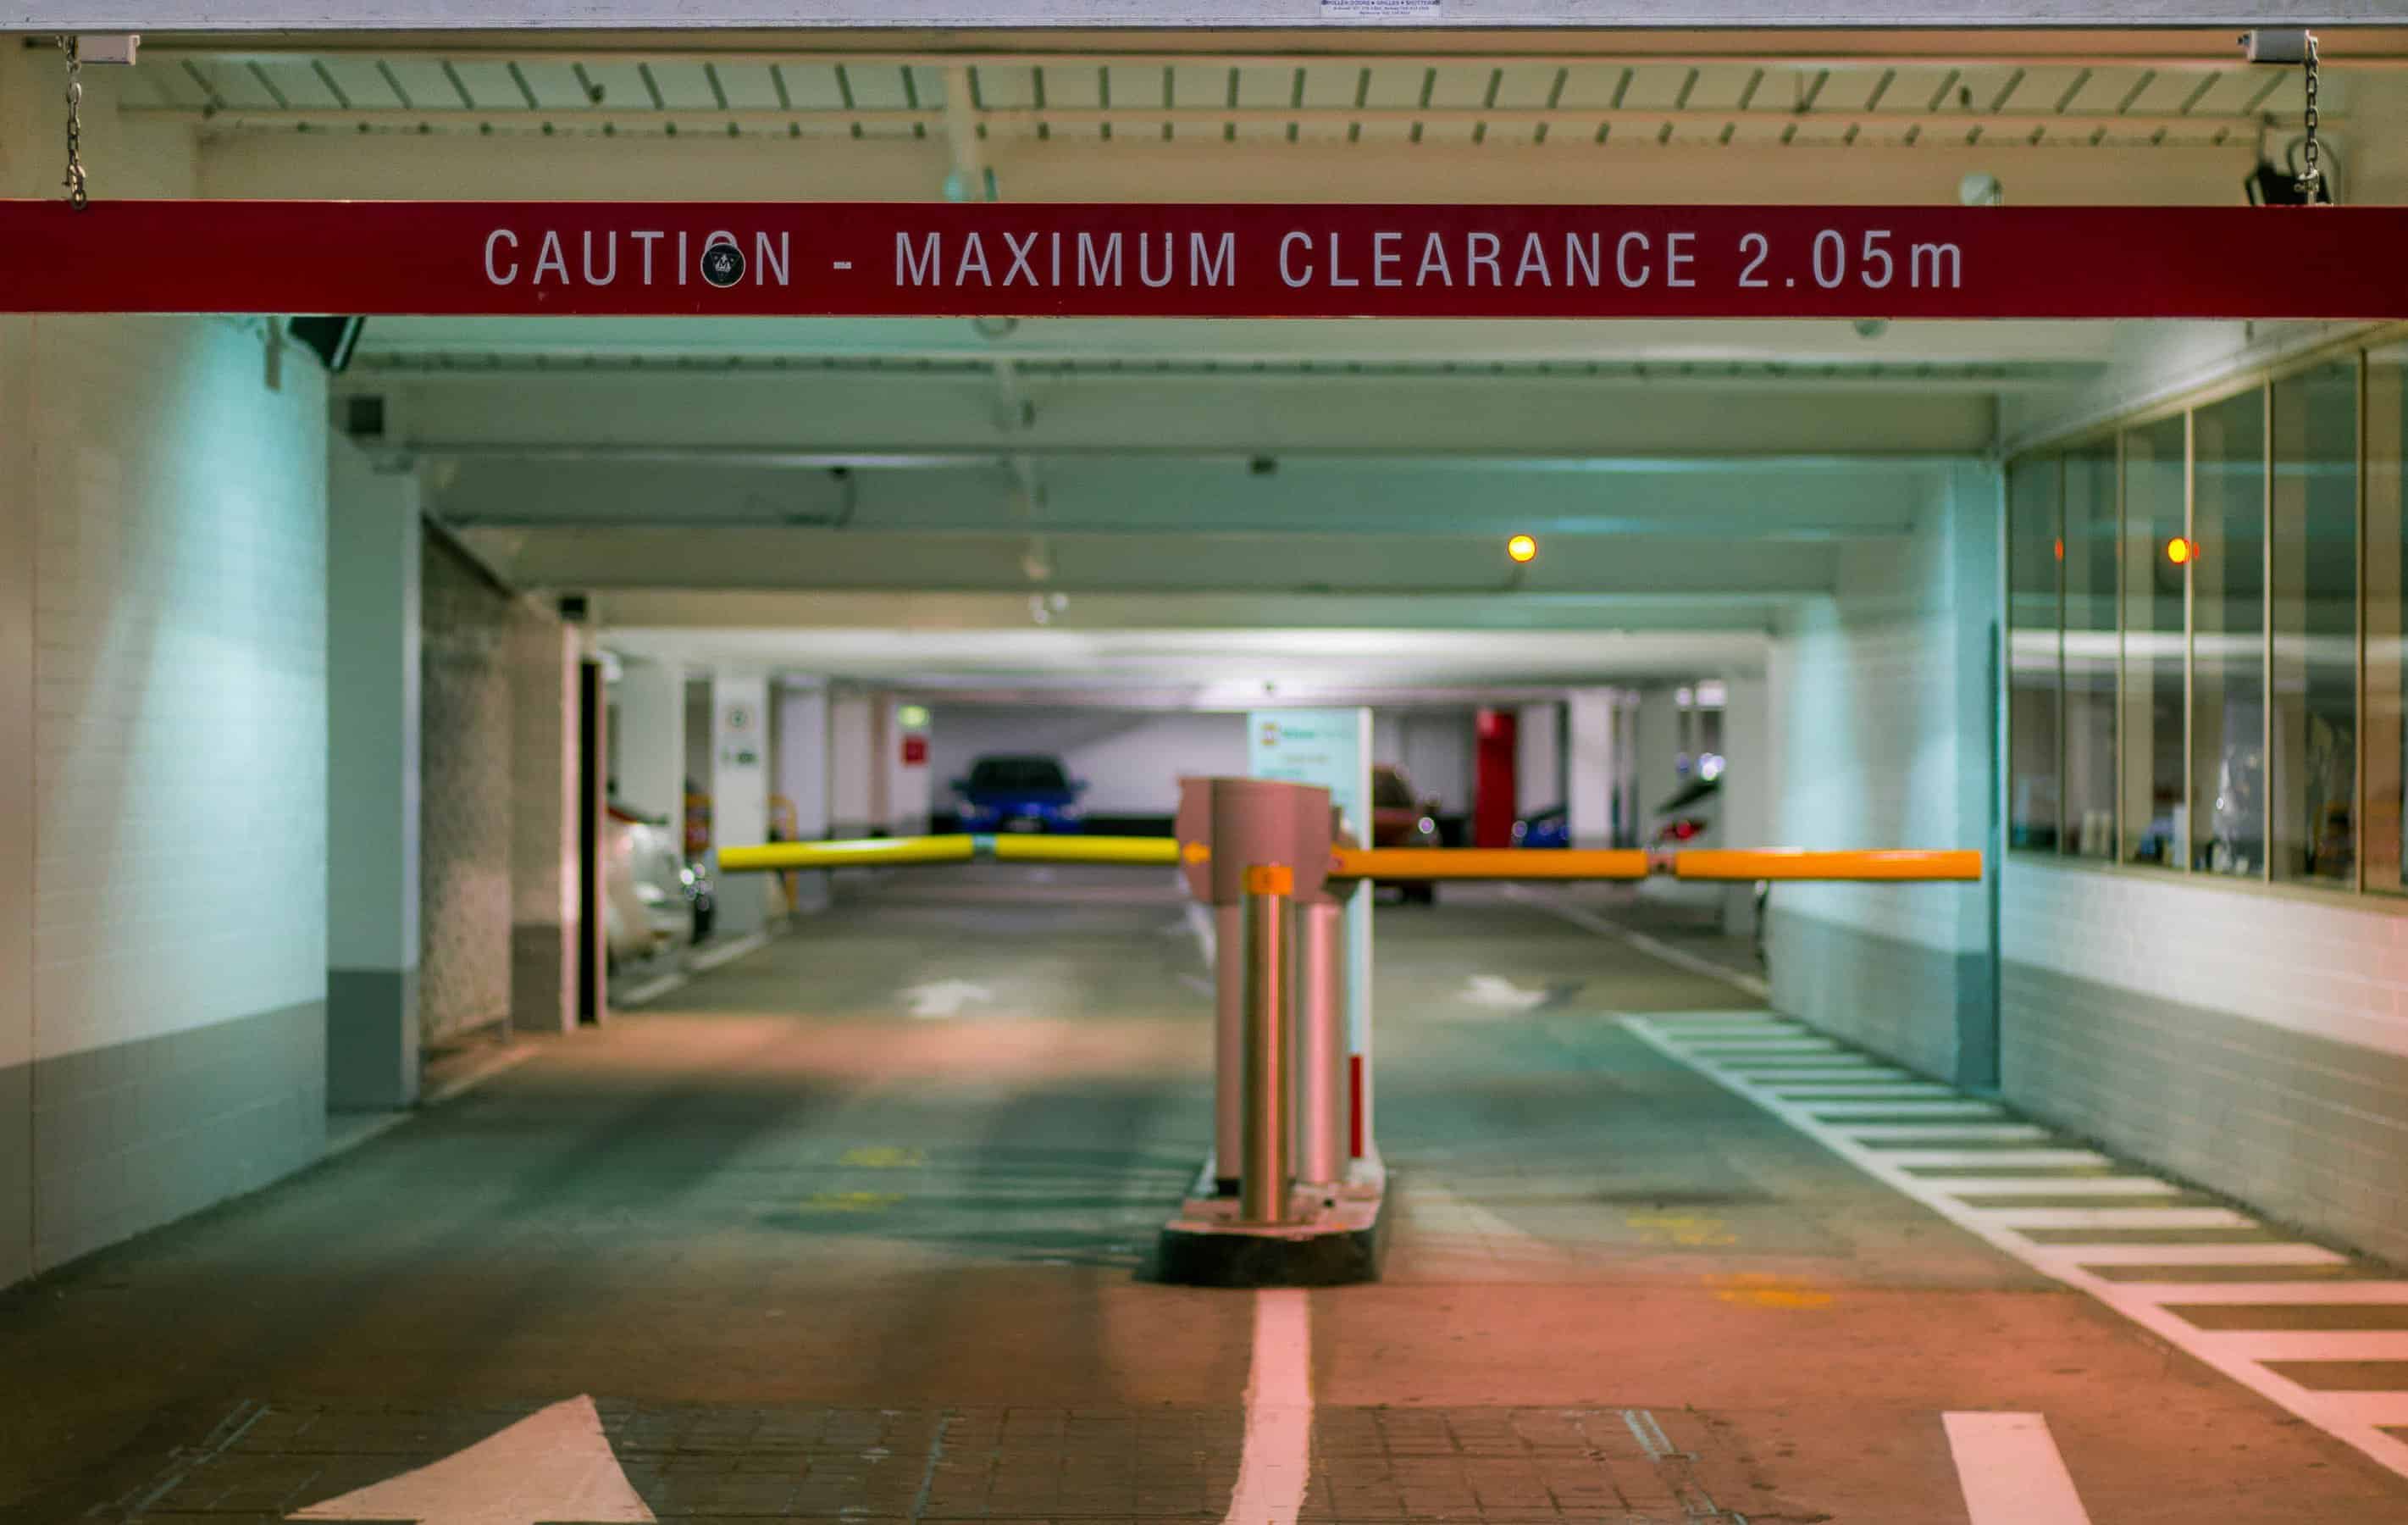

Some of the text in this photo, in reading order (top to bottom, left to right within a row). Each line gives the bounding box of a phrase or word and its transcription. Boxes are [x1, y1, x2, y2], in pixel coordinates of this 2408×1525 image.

[896, 231, 1235, 286] MAXIMUM
[1280, 231, 1696, 288] CLEARANCE
[1739, 229, 1961, 289] 2.05m
